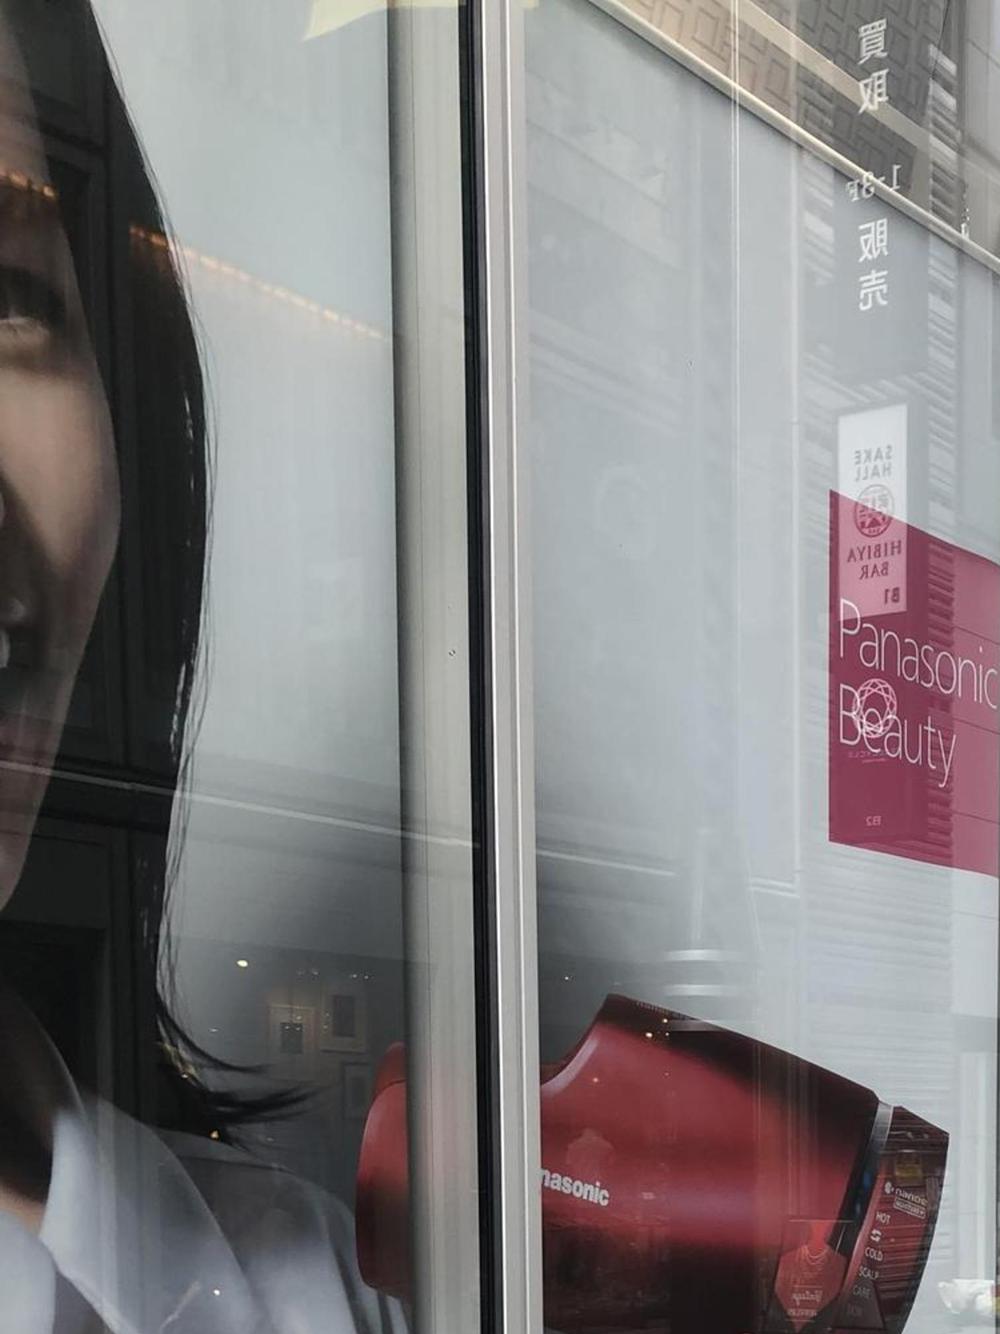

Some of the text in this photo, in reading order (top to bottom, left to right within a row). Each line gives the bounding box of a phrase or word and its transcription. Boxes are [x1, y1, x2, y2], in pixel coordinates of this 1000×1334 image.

[839, 598, 999, 710] Panasonic
[839, 683, 957, 788] Beauty
[543, 1168, 610, 1207] nasonic
[876, 1211, 892, 1224] HOT
[864, 1246, 884, 1262] COLD
[859, 1266, 880, 1280] SCALP
